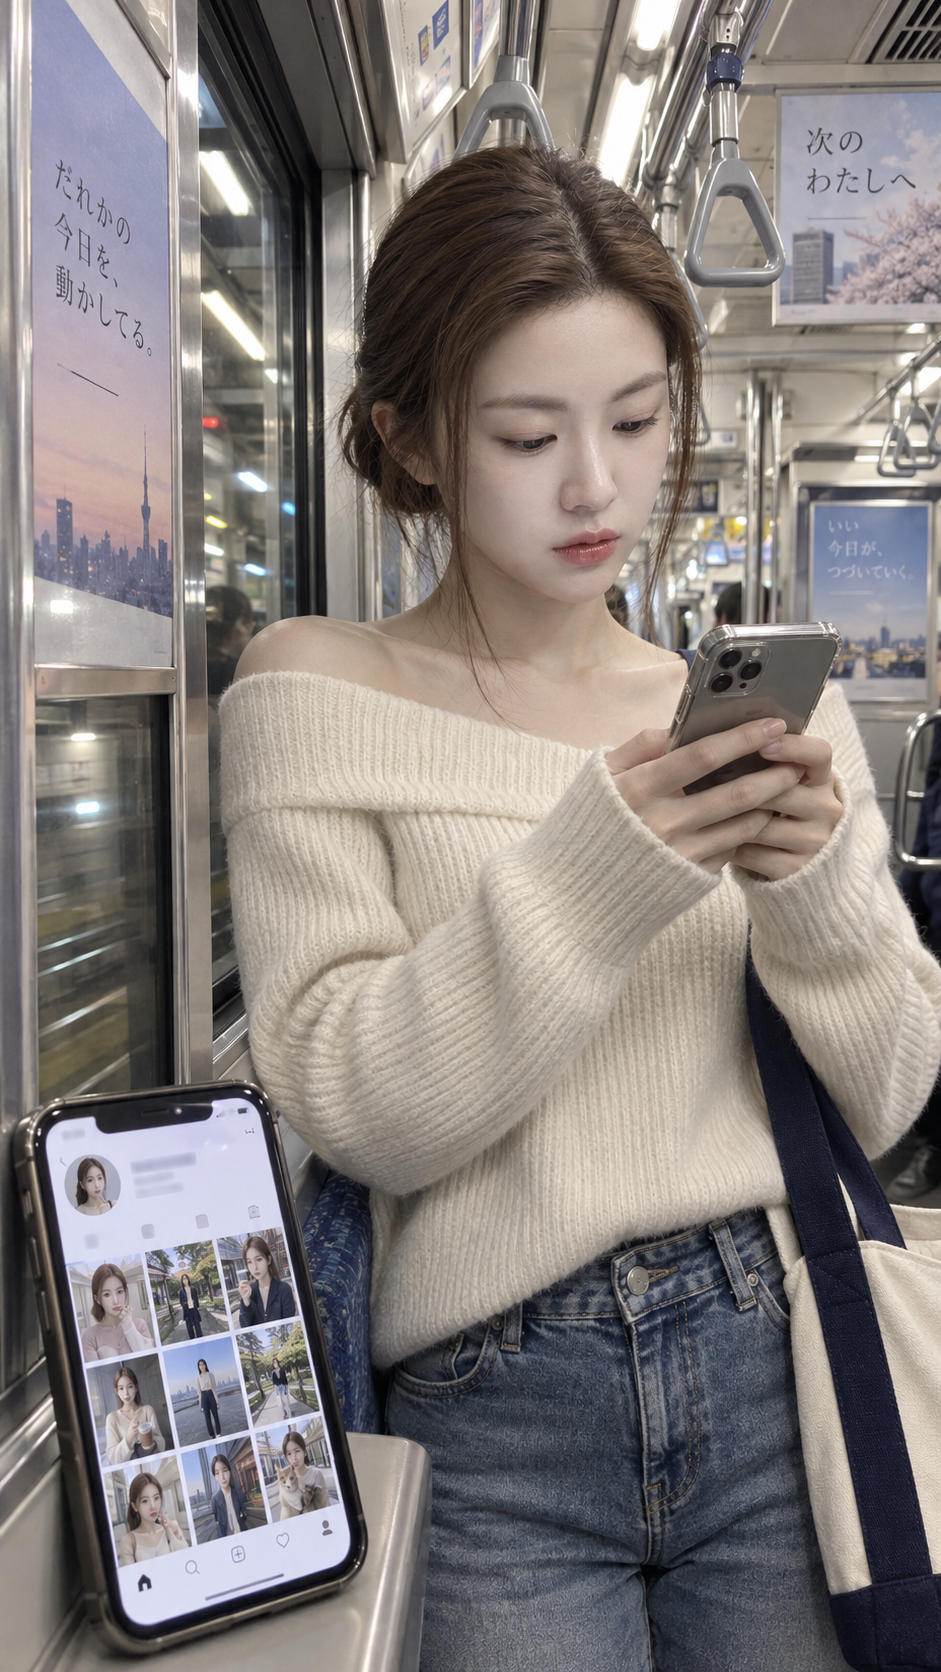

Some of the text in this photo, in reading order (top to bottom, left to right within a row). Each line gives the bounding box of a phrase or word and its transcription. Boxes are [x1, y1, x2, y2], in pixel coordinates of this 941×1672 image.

[807, 127, 863, 156] 次の
[807, 167, 916, 194] わたしへ
[55, 159, 131, 245] だれかの
[54, 213, 119, 288] 今日を、
[55, 265, 152, 357] 動かしてる。
[828, 520, 860, 533] いい
[827, 540, 883, 557] 今日が、
[827, 564, 914, 580] つづいていく。
